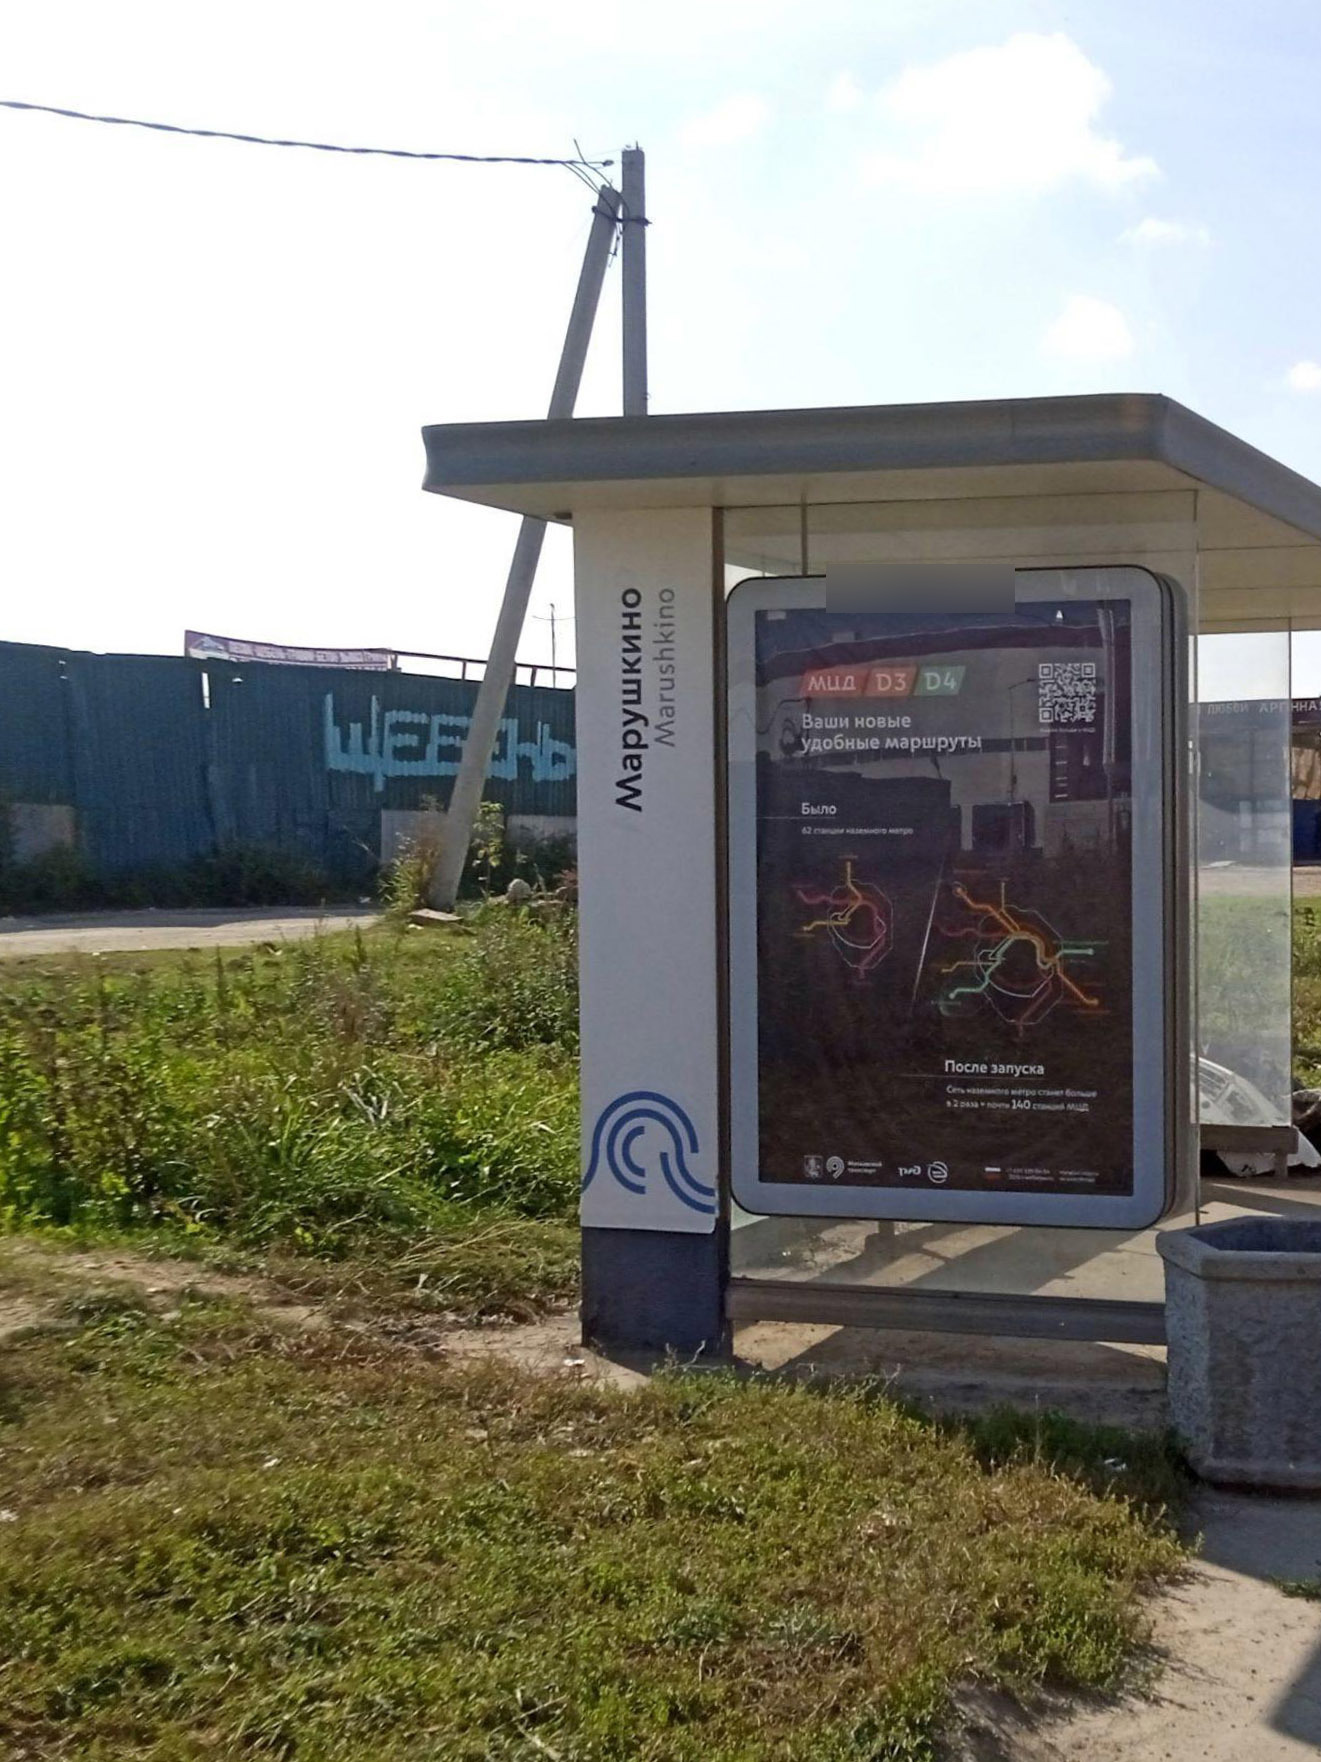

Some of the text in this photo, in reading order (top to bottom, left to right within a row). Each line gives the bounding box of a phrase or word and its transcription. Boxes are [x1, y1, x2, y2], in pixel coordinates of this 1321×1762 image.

[652, 587, 676, 748] Marushkino
[807, 672, 956, 691] МЦД D3 D4
[615, 587, 649, 813] Марушкино
[801, 713, 912, 730] Ваши новые
[325, 693, 577, 792] ЩЕБНЬ
[800, 733, 982, 754] удобные маршруты
[801, 802, 838, 816] Было
[944, 1059, 1045, 1078] После запуска
[1011, 1099, 1032, 1111] 140
